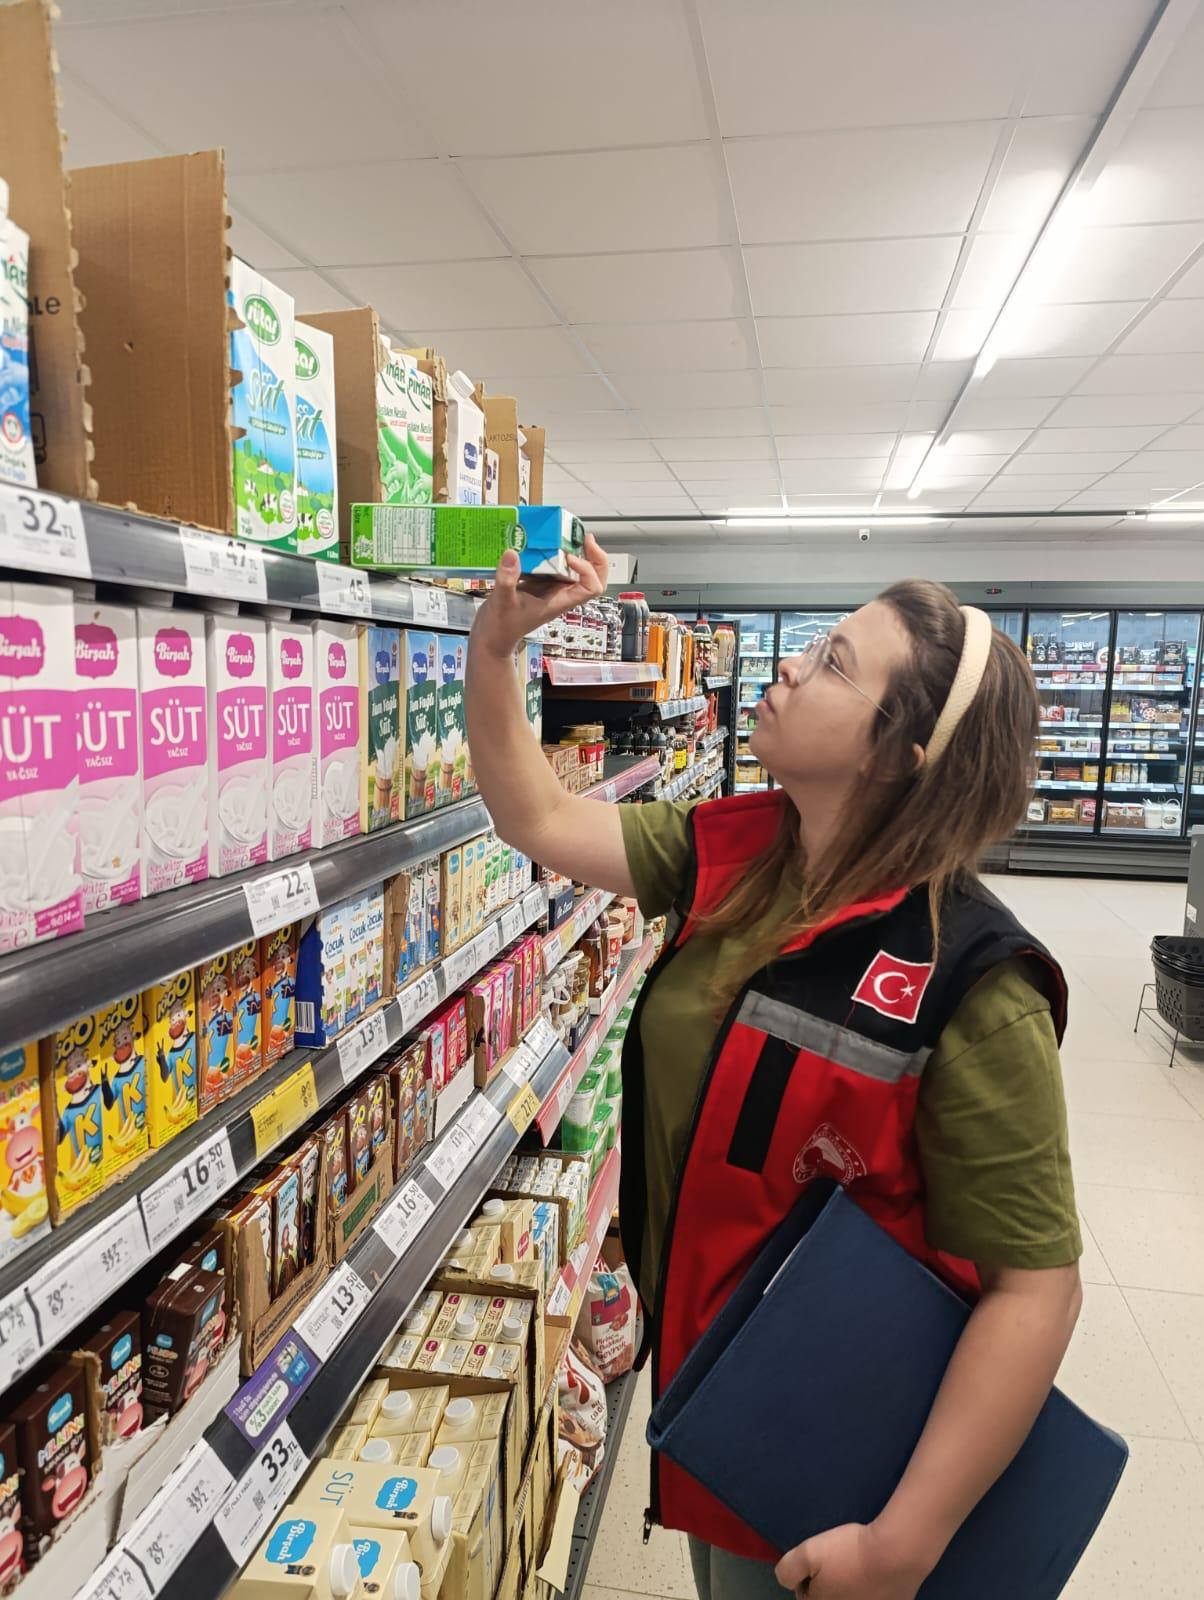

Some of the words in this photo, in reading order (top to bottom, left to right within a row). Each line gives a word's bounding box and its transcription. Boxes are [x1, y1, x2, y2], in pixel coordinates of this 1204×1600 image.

[408, 378, 431, 401] PINAR
[18, 495, 62, 537] 32
[62, 524, 77, 540] TL
[156, 642, 191, 662] Birşah
[227, 646, 254, 665] Birşah
[150, 698, 203, 746] SÜT
[222, 697, 265, 741] SÜT
[278, 697, 311, 736] SÜT
[325, 696, 354, 731] SÜT
[0, 705, 62, 763] ÜT
[6, 767, 39, 781] YAĞSIZ
[85, 756, 114, 768] YAĞSIZ
[283, 871, 304, 898] 22
[215, 1160, 225, 1172] TL
[250, 1409, 266, 1432] %3
[261, 1438, 289, 1482] 33
[287, 1441, 298, 1454] TL
[320, 1470, 354, 1506] SÜT
[386, 1479, 408, 1508] Birşah
[278, 1521, 306, 1561] Birşah
